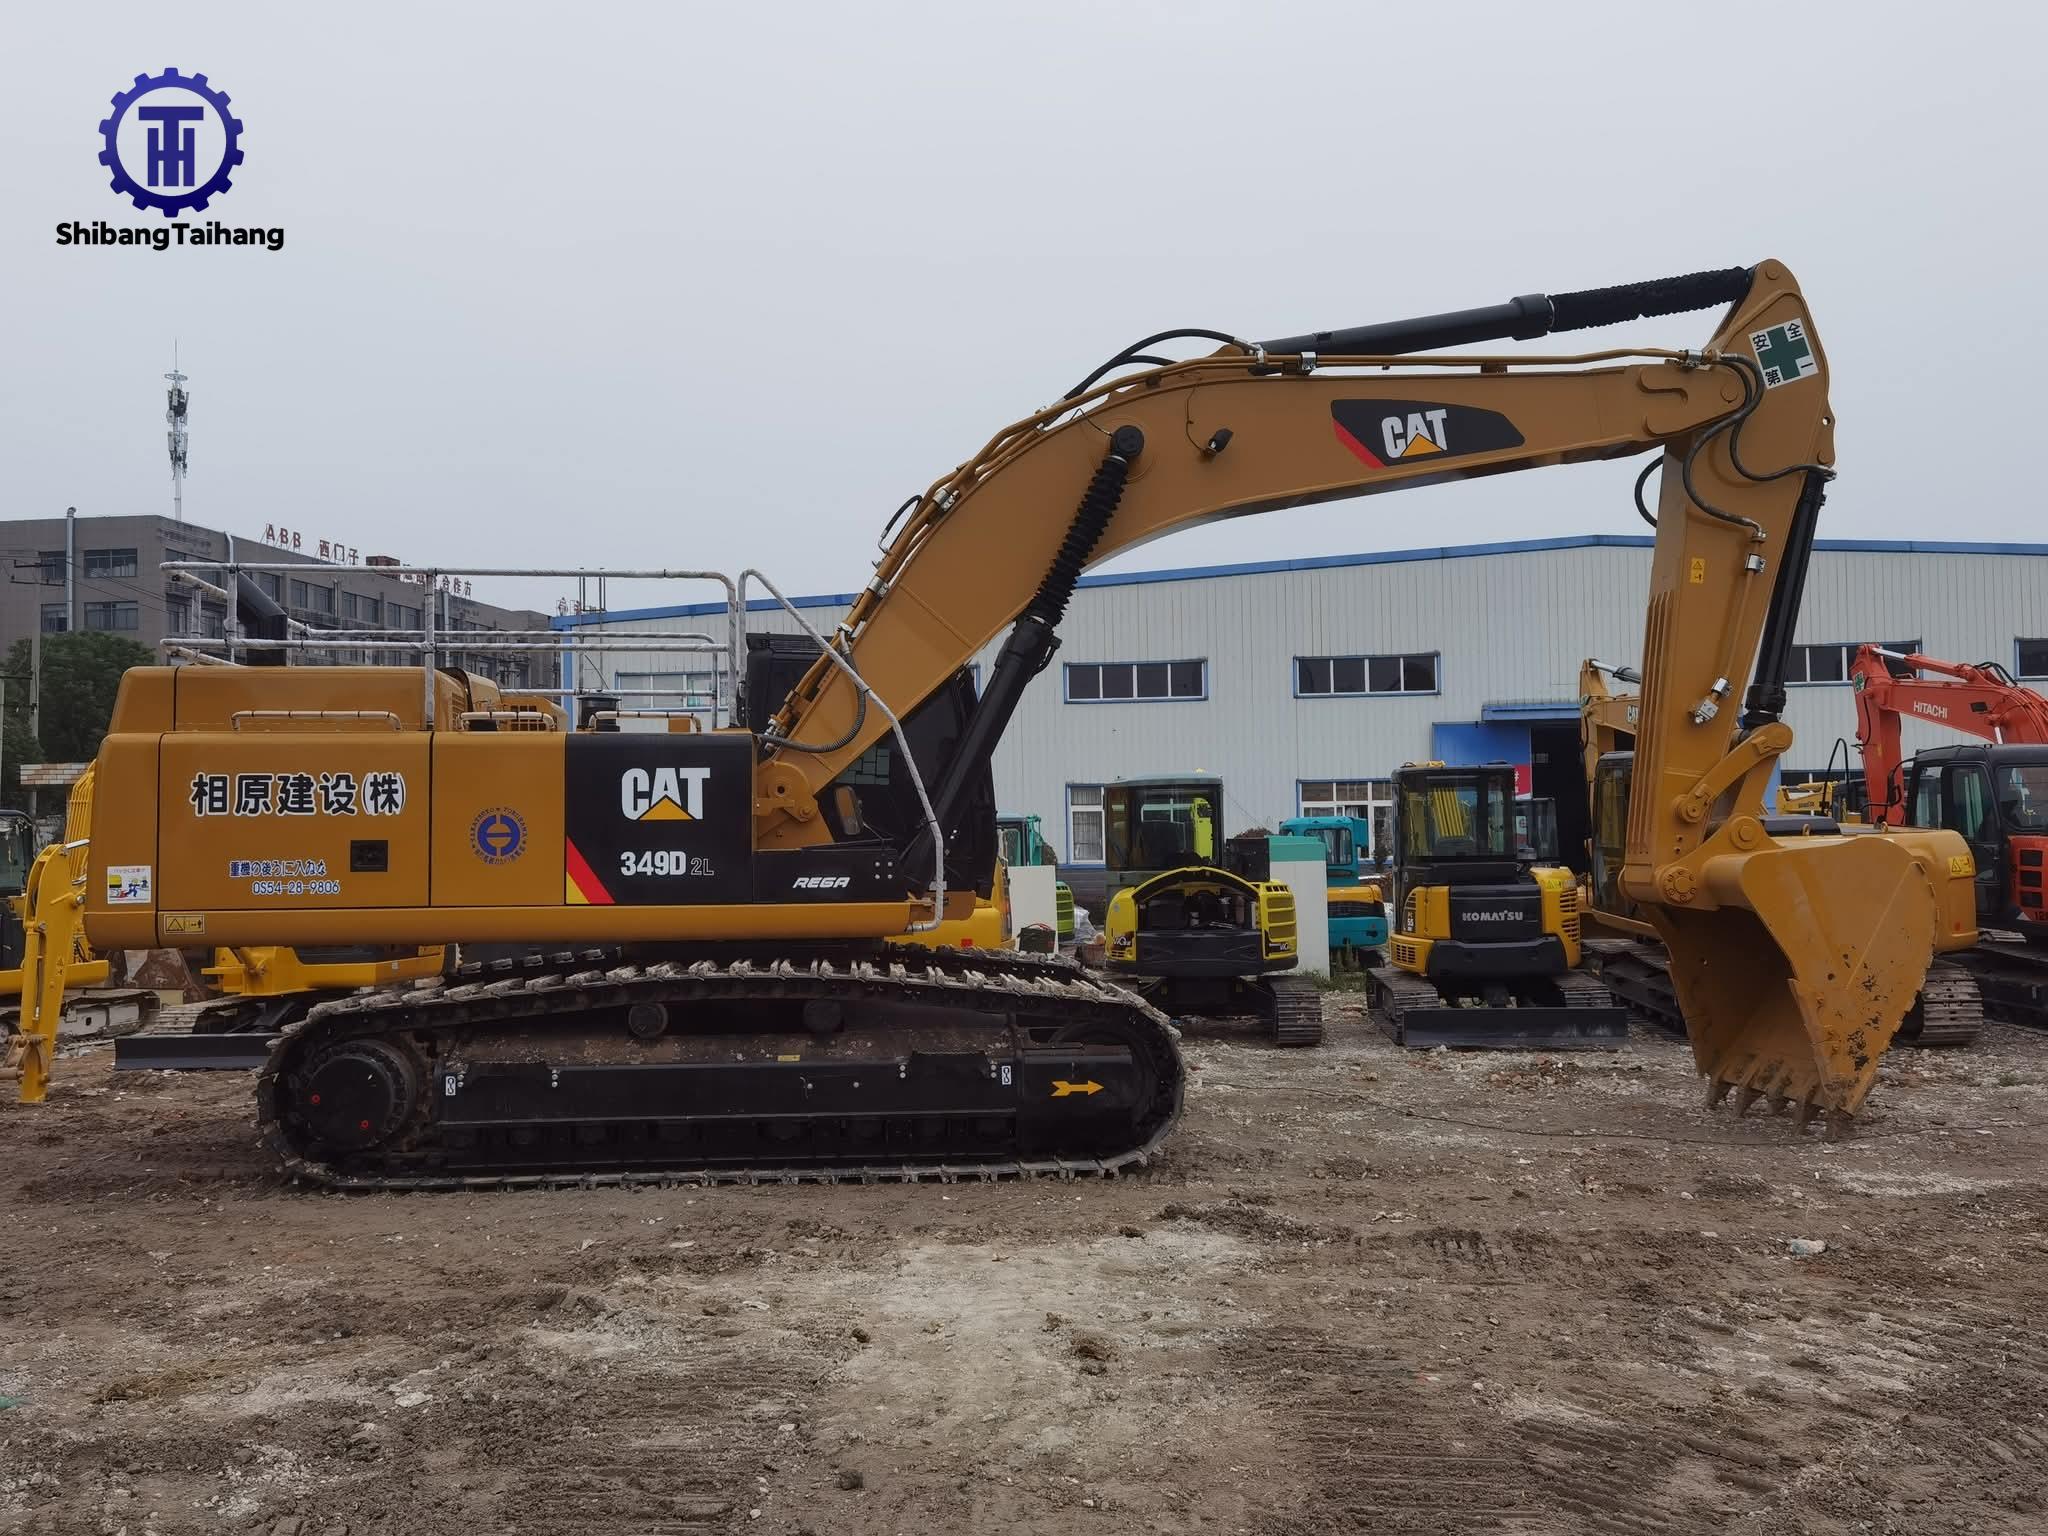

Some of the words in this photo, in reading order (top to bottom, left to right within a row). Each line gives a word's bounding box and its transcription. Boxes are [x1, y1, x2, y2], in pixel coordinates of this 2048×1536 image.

[1381, 409, 1448, 459] CAT
[265, 523, 301, 548] ABB
[1913, 701, 1948, 719] HITACHI
[620, 767, 711, 821] CAT
[620, 850, 686, 876] 349D
[690, 857, 714, 876] 2L
[792, 877, 851, 888] REGA
[1462, 910, 1524, 921] KOMATSU
